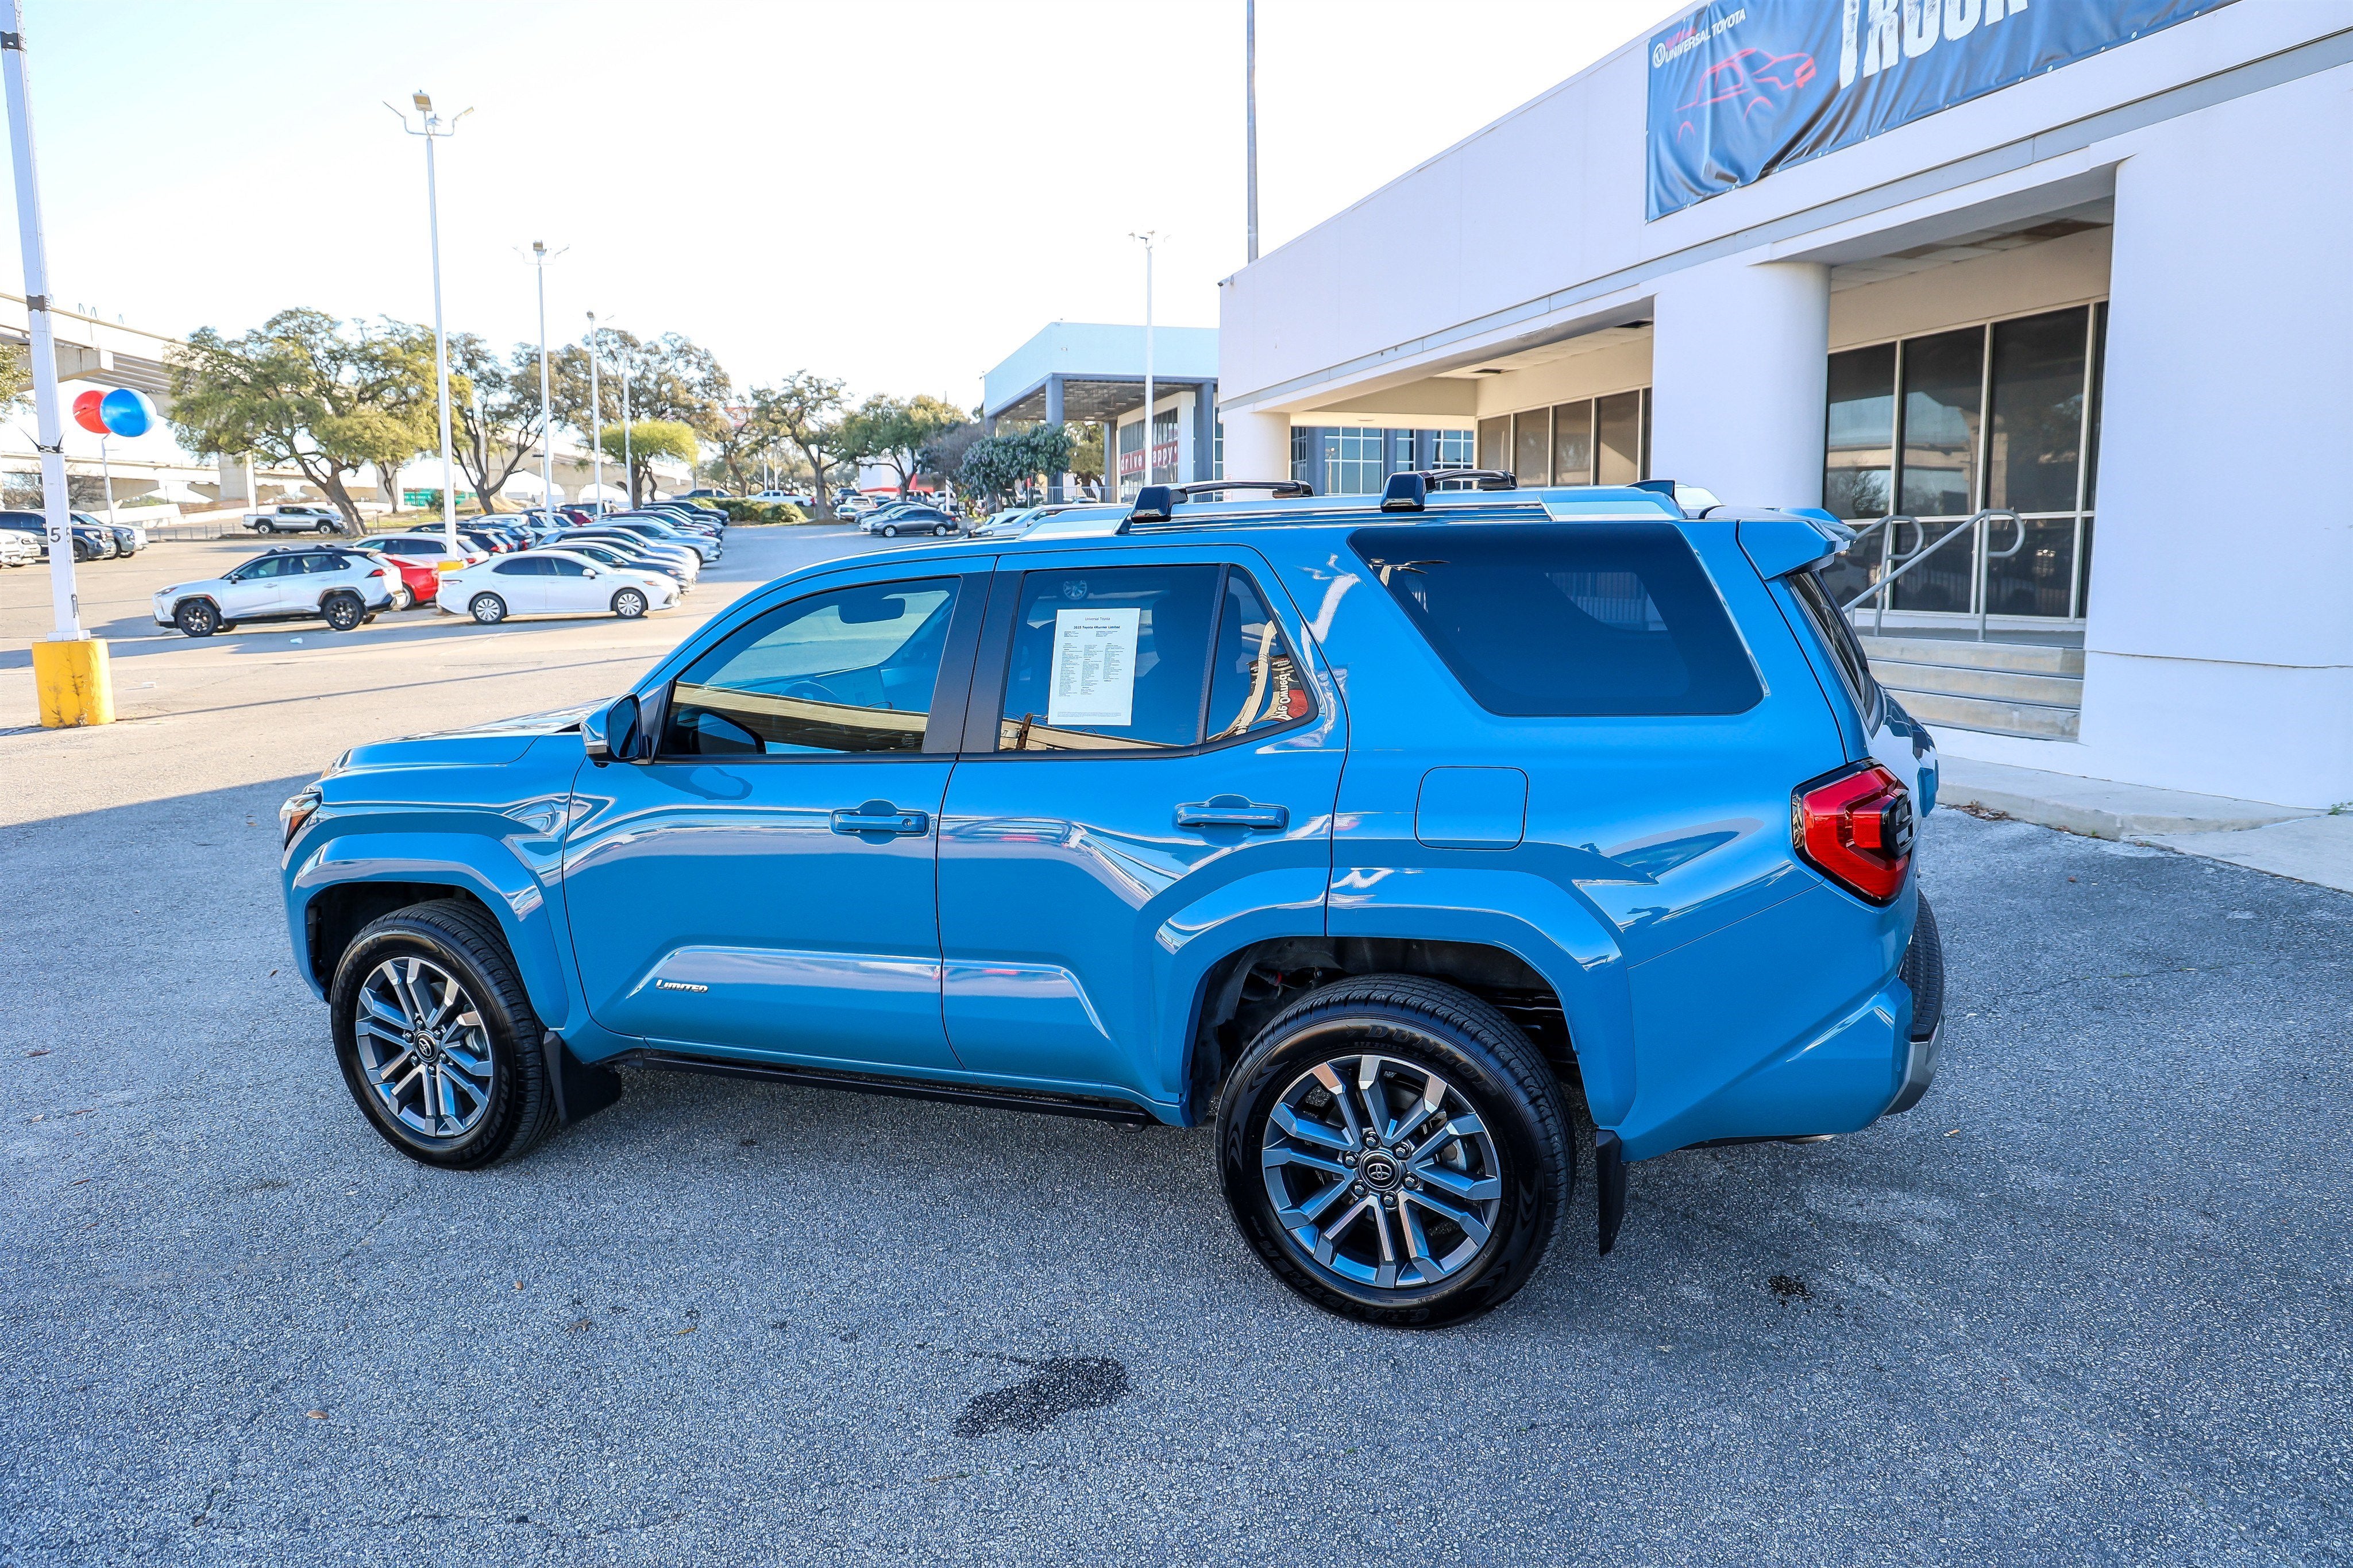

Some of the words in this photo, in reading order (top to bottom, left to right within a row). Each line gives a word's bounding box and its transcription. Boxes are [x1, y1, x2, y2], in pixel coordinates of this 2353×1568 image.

[1665, 28, 1711, 63] UNIVERSAL
[1711, 7, 1747, 37] TOYOTA
[1121, 453, 1143, 471] drive
[1152, 446, 1172, 466] appy
[50, 527, 61, 543] 5
[1365, 1024, 1499, 1095] DUNLOP
[1257, 1239, 1430, 1322] GRANDTREK
